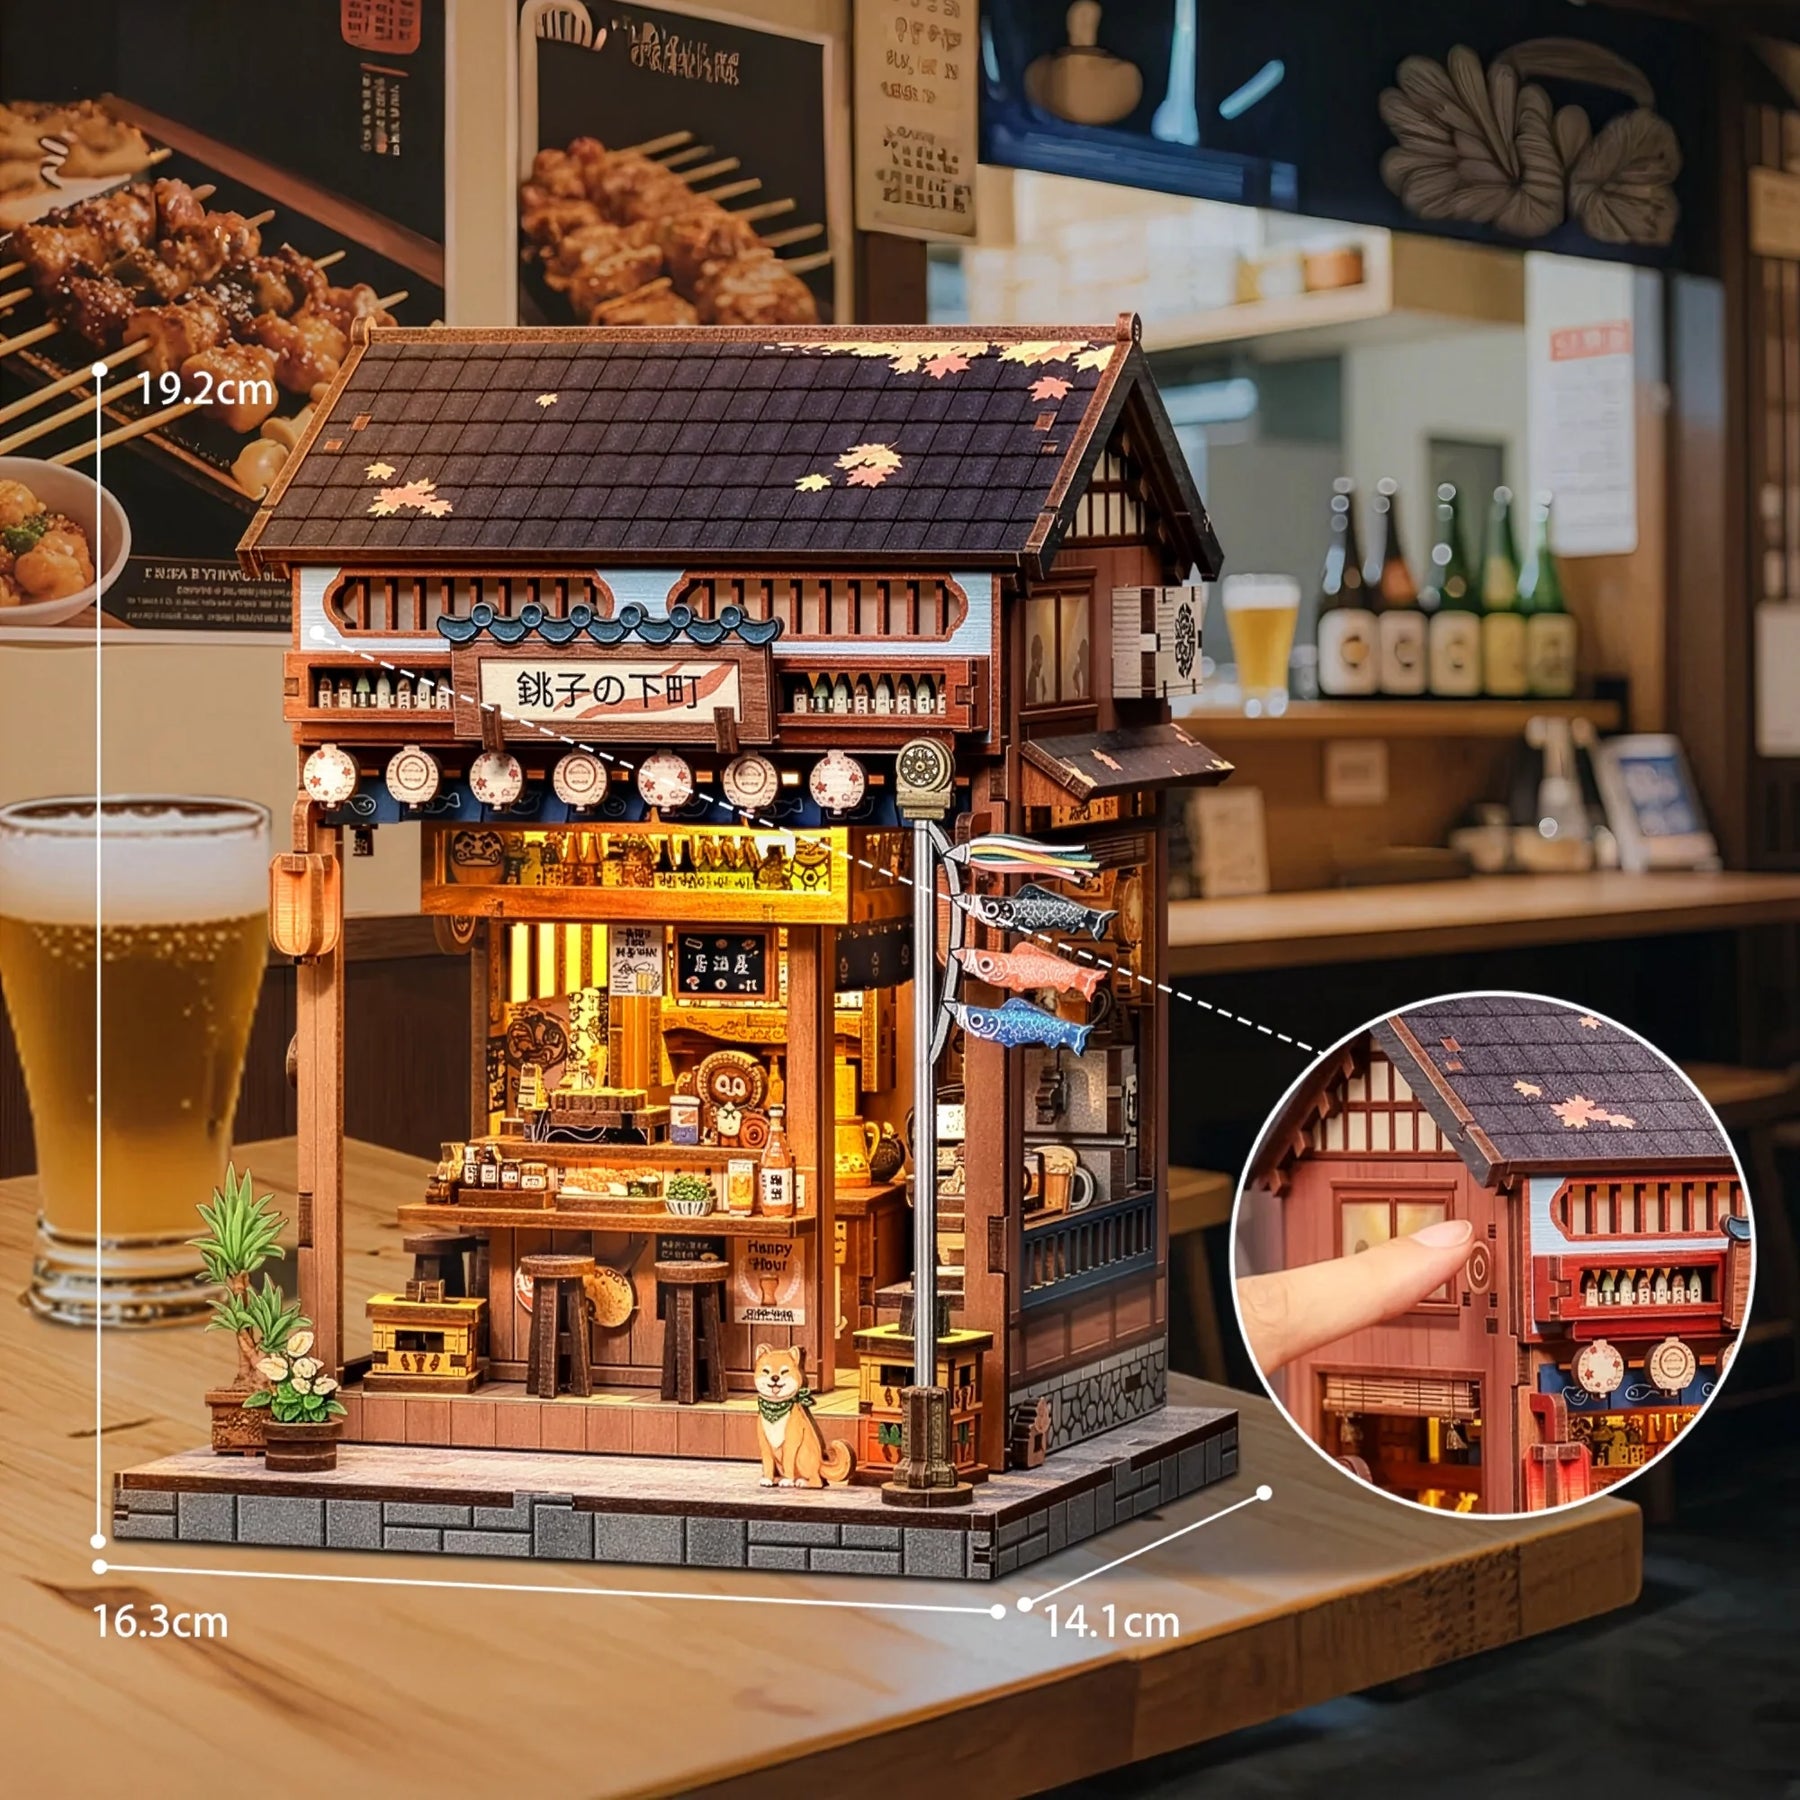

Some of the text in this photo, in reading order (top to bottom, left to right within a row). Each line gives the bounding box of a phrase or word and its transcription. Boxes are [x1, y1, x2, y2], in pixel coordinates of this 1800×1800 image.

[517, 670, 702, 709] 銚子の下町
